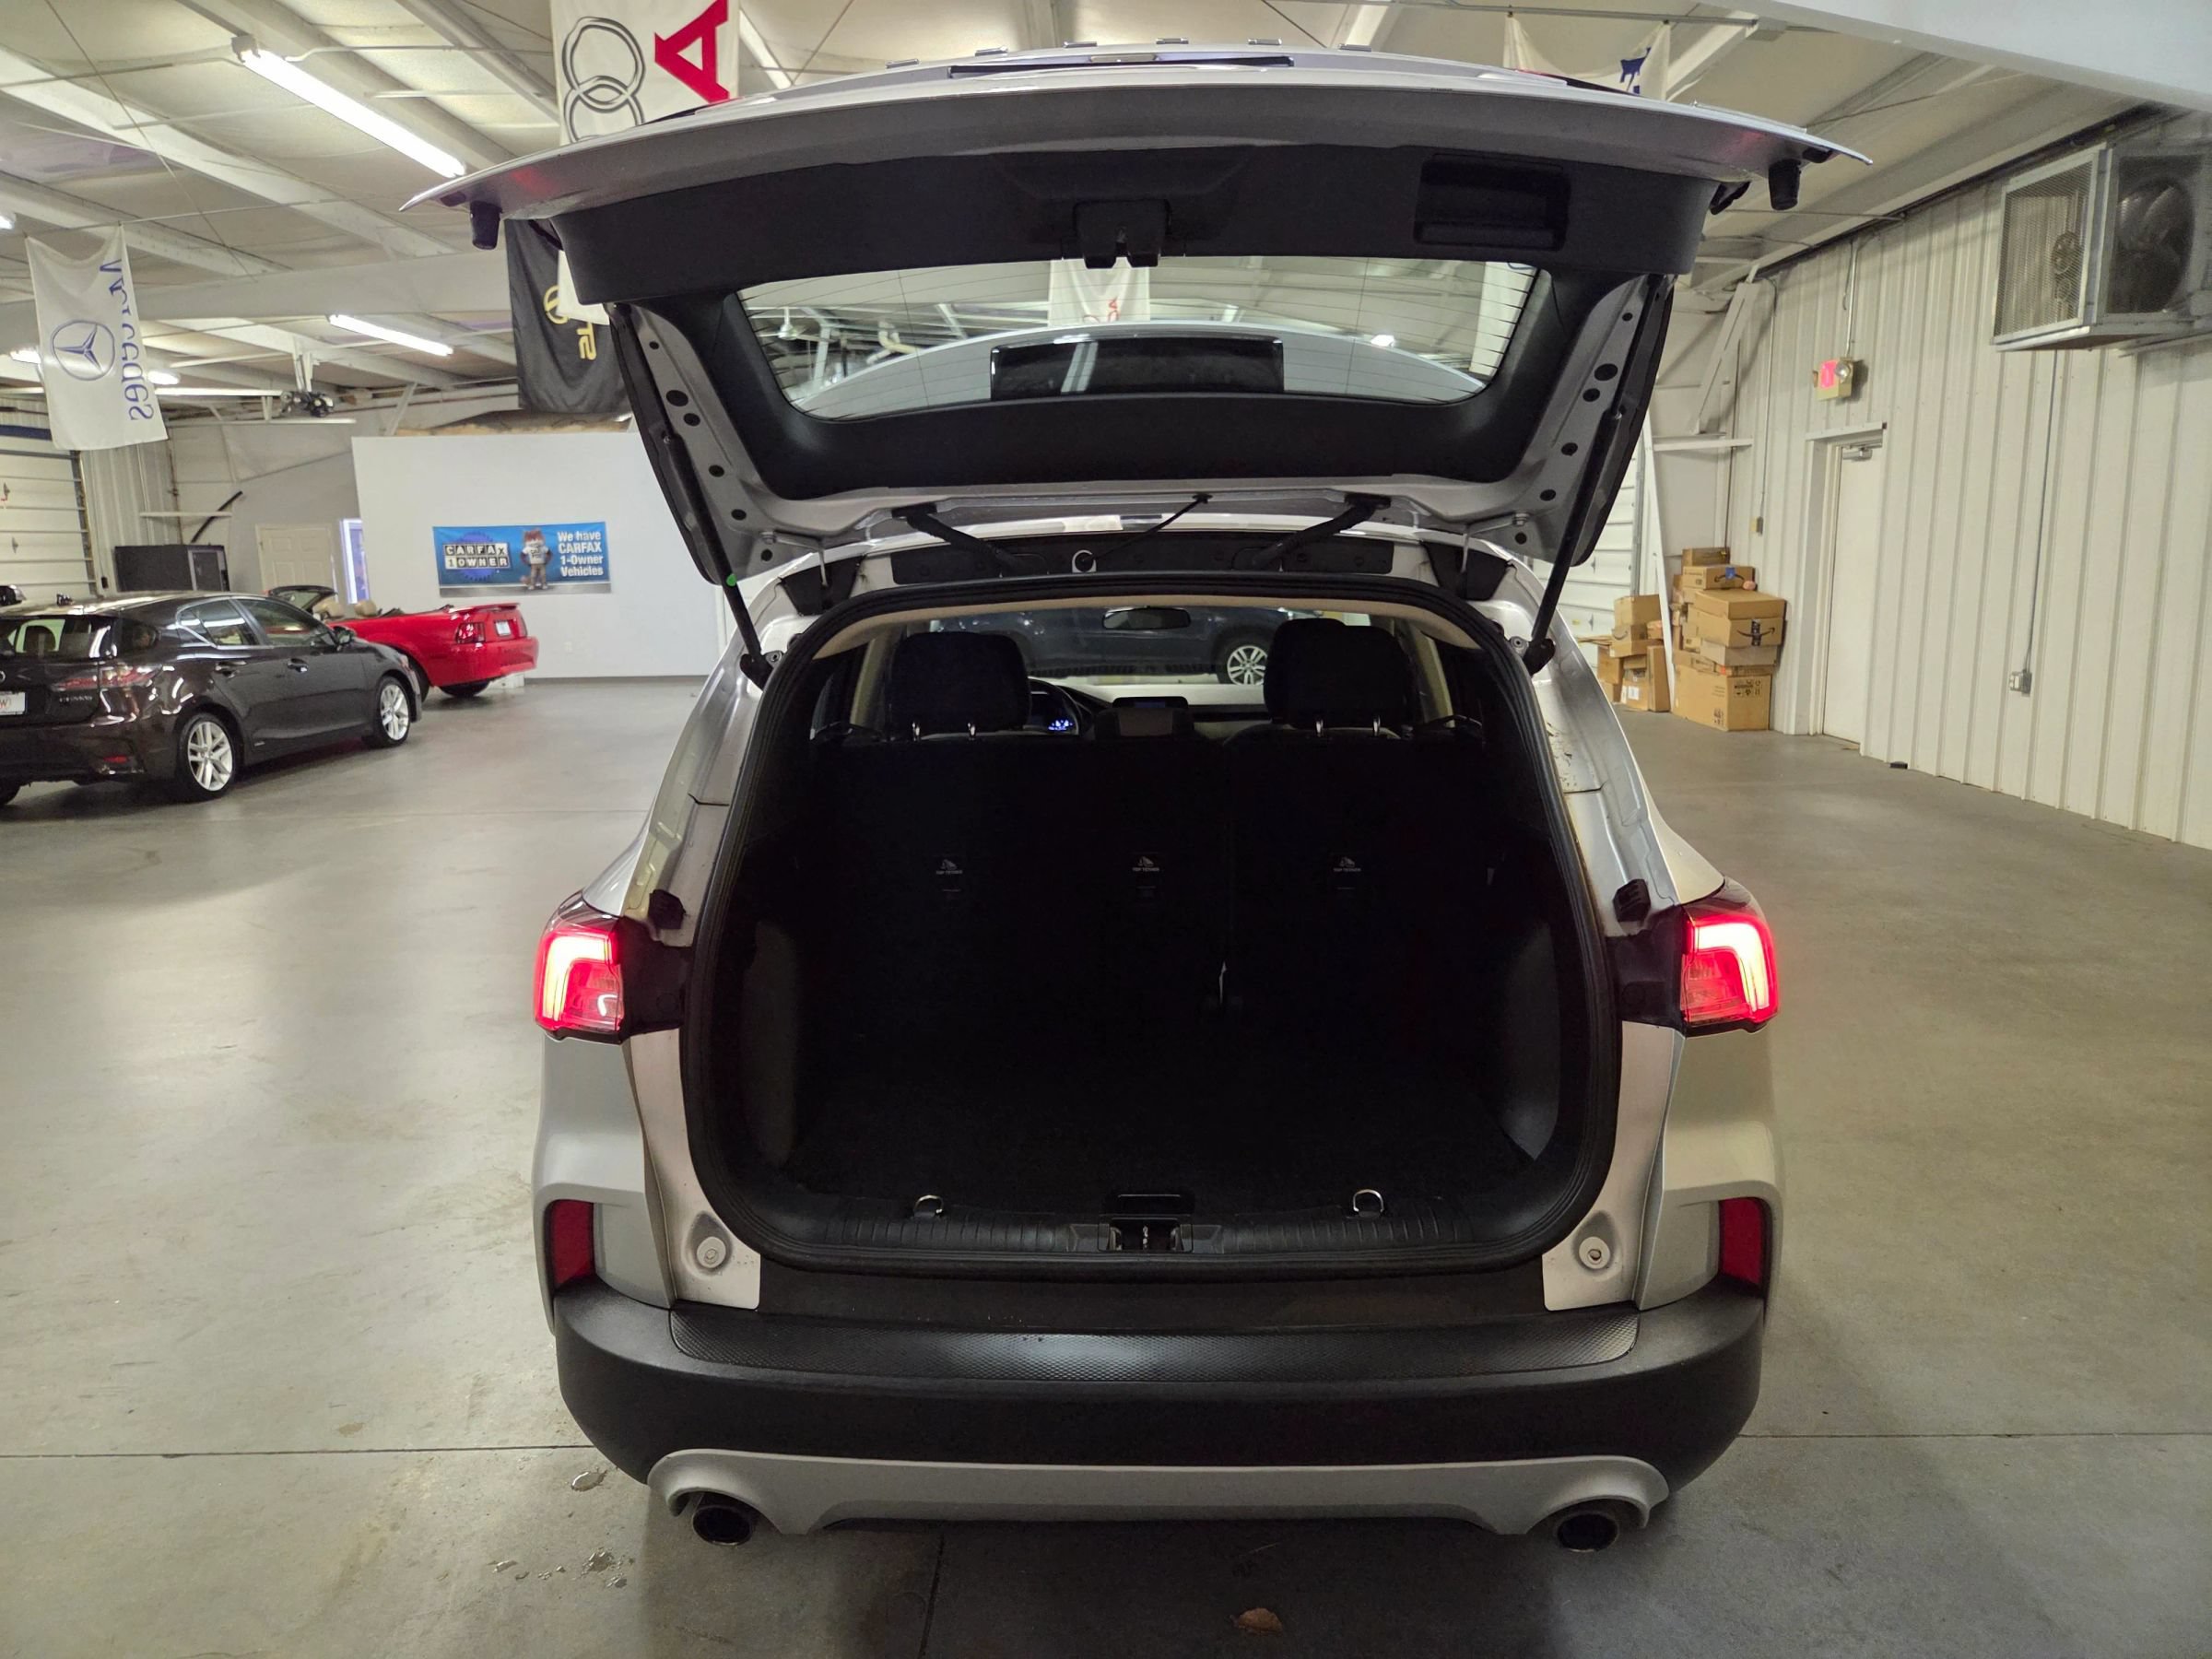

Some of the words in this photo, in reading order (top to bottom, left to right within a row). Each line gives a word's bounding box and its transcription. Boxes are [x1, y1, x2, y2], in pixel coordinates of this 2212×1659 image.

[558, 531, 573, 542] We
[575, 531, 602, 542] have
[445, 545, 506, 556] CARFAX
[558, 541, 603, 554] CARFAX
[560, 554, 605, 566] 1-Owner
[560, 565, 605, 577] Vehicles
